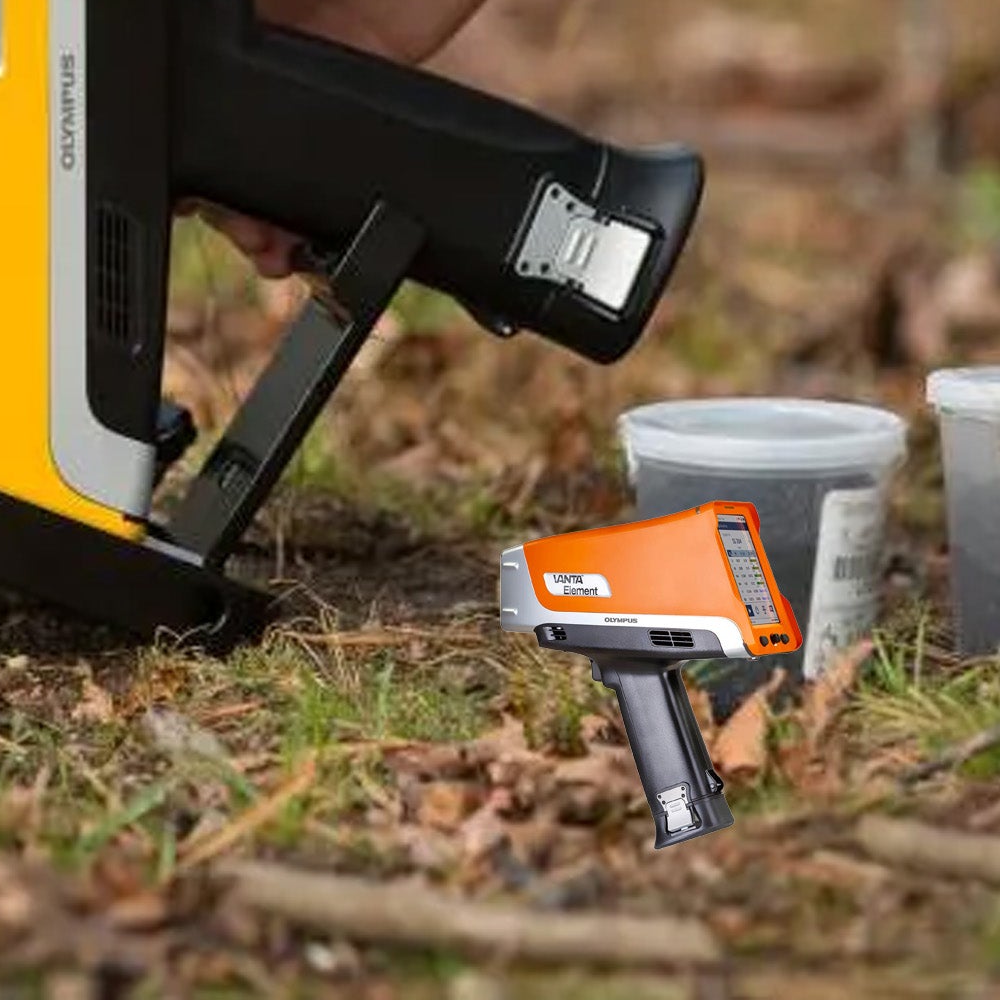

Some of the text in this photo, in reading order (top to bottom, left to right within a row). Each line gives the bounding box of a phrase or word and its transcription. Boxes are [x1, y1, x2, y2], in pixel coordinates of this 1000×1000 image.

[61, 55, 75, 170] OLYMPUS
[553, 574, 583, 584] VANTA
[563, 586, 598, 596] Element
